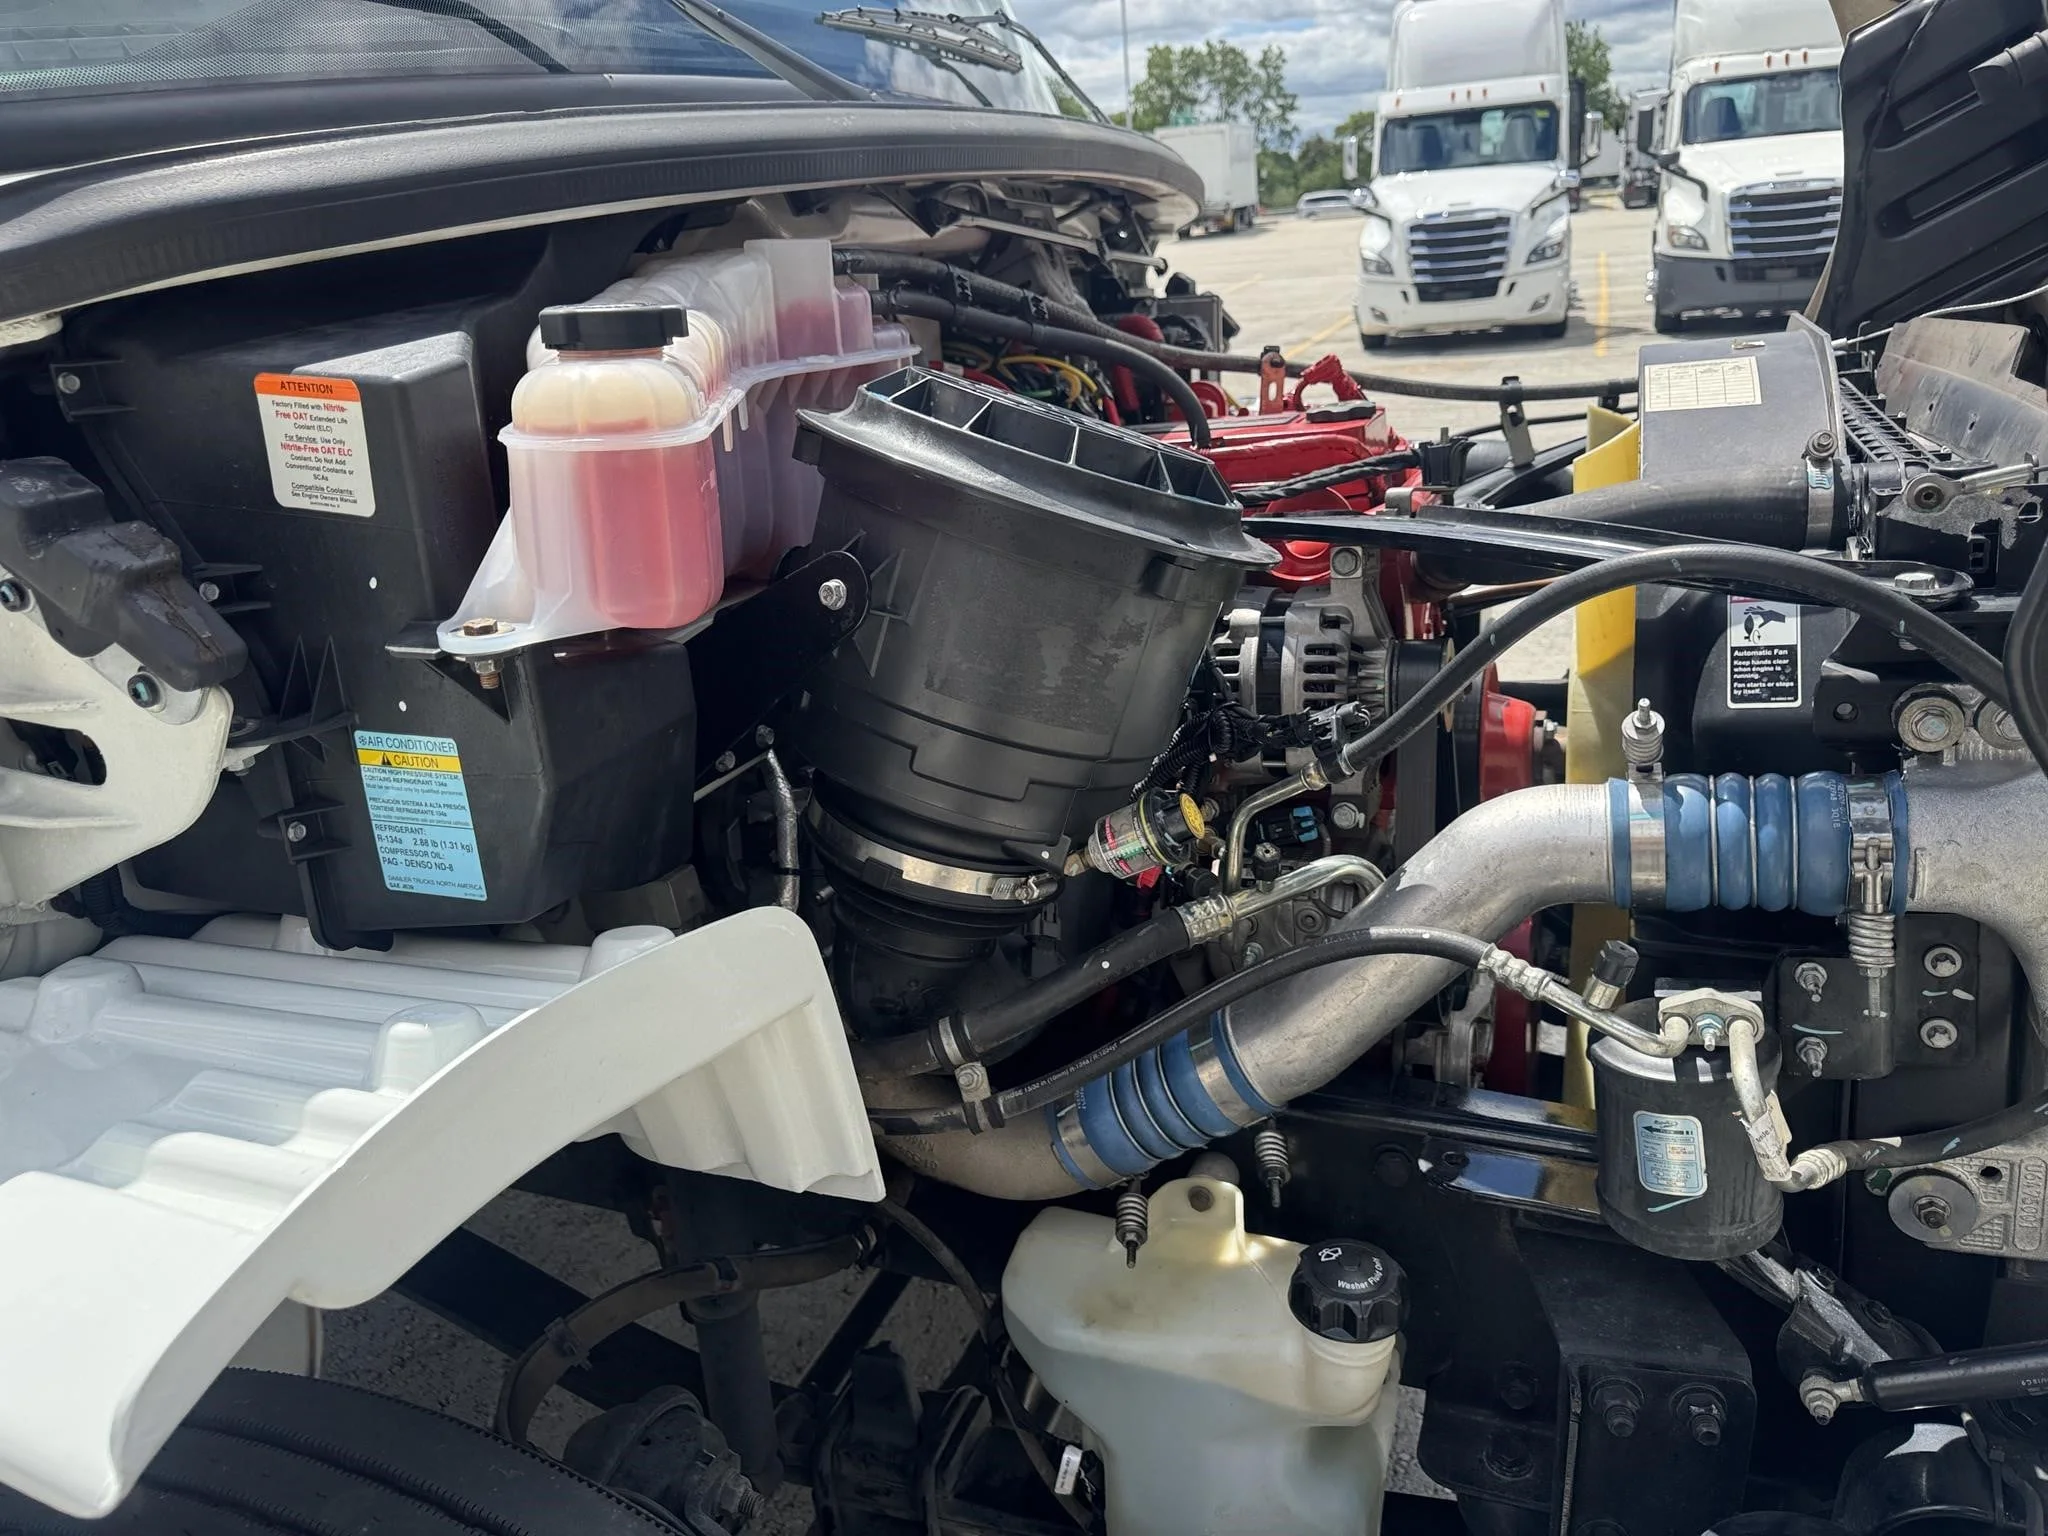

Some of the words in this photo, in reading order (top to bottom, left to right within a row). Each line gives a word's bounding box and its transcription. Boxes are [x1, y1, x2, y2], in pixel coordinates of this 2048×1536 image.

[280, 381, 333, 393] ATTENTION
[272, 400, 293, 409] Factory
[324, 403, 348, 412] Nitrite-
[275, 411, 291, 419] Free
[293, 412, 307, 420] OAT
[310, 415, 336, 423] Extended
[317, 425, 332, 433] (ELC)
[281, 442, 319, 454] Nitrite-Free
[332, 438, 345, 446] Only
[285, 462, 321, 471] Conventional
[322, 466, 346, 474] Coolants
[291, 482, 324, 492] Compatible
[320, 494, 338, 502] Owners
[368, 736, 384, 746] AIR
[385, 738, 456, 753] CONDITIONER
[393, 755, 439, 768] CAUTION
[403, 770, 433, 778] PRESSURE
[393, 777, 433, 786] REFRIGERANT
[396, 807, 434, 816] REFRIGERANTE
[375, 824, 426, 835] REFRIGERANT:
[377, 834, 402, 844] R-134a
[413, 838, 429, 847] 2.88
[430, 839, 438, 847] lb
[440, 840, 458, 850] (1.31
[460, 842, 473, 853] kg)
[380, 846, 429, 857] COMPRESSOR
[382, 857, 398, 865] PAG
[405, 859, 432, 869] DENSO
[435, 863, 454, 871] ND-8
[1372, 1257, 1382, 1270] Only
[1368, 1270, 1383, 1285] Fluid
[1338, 1280, 1368, 1290] Washer
